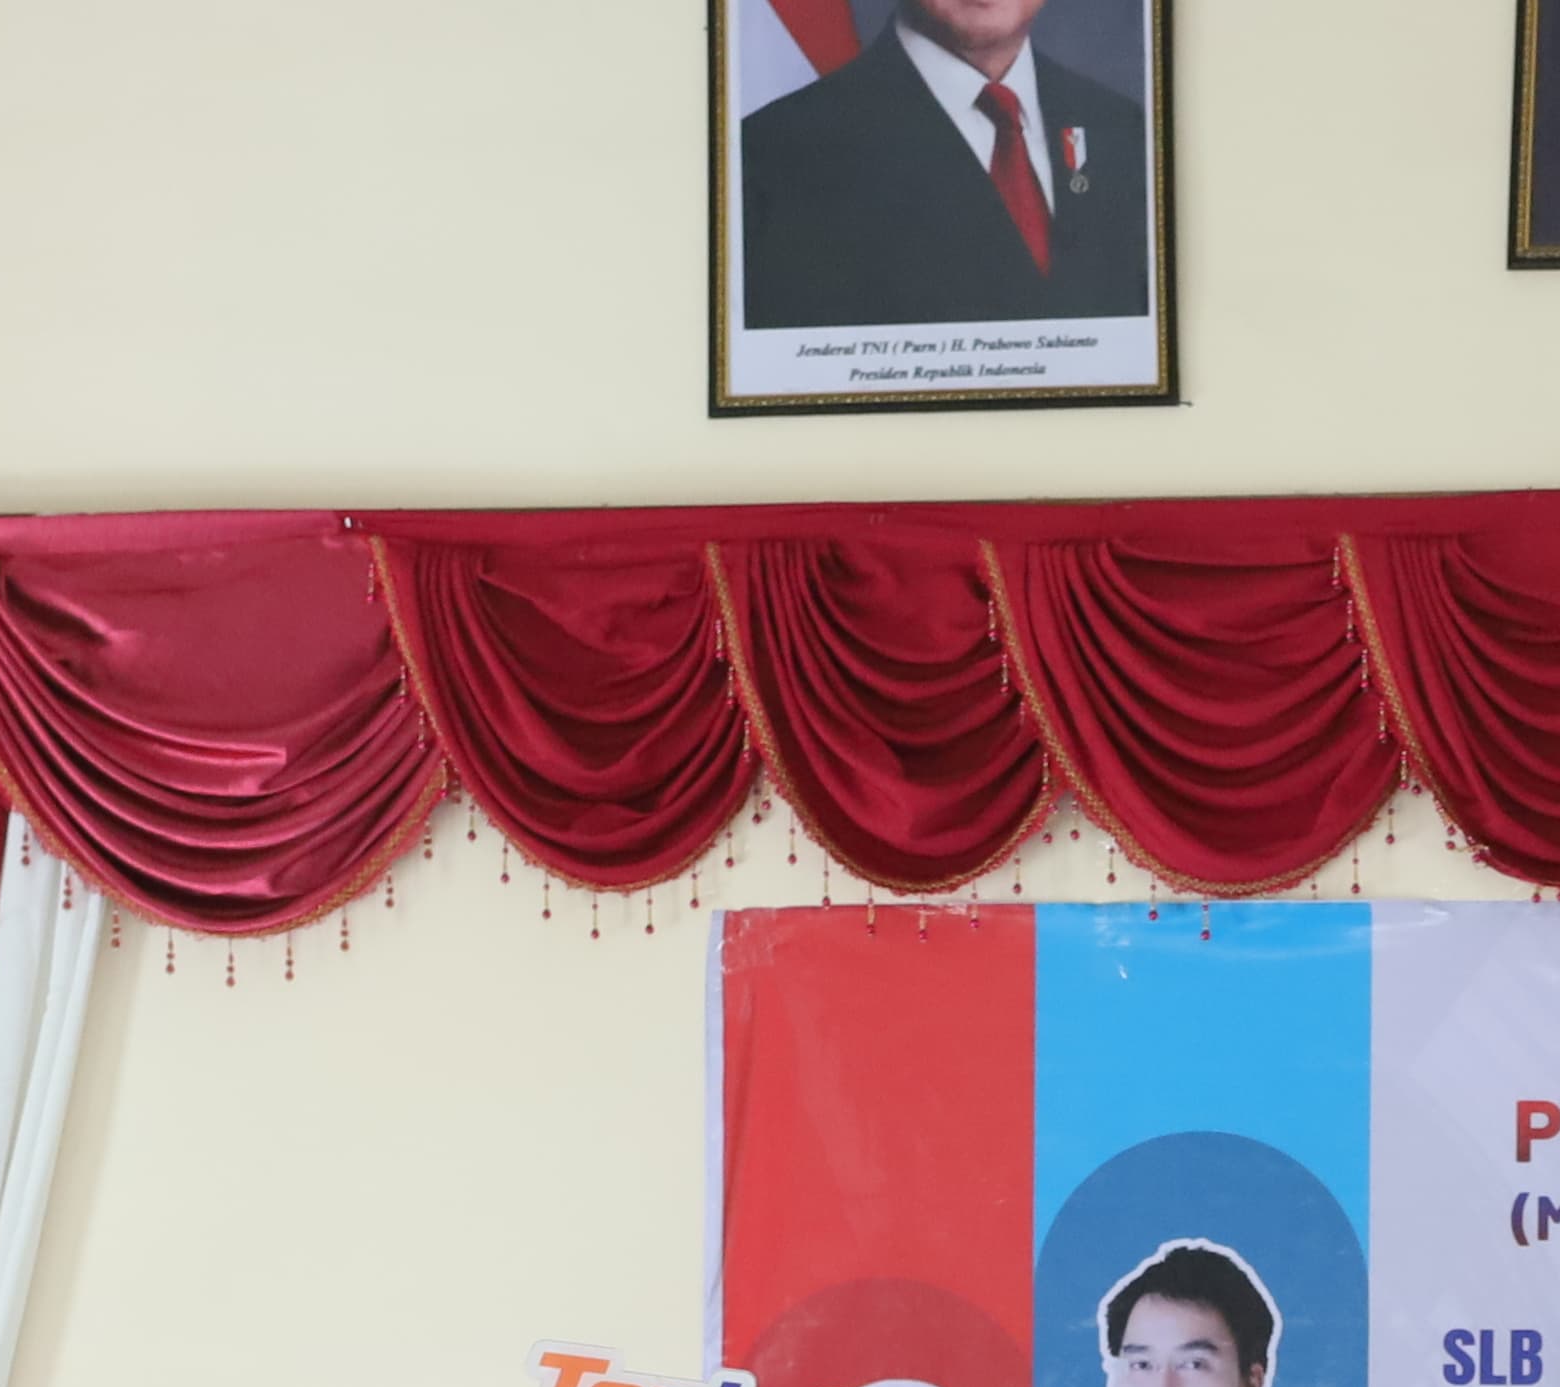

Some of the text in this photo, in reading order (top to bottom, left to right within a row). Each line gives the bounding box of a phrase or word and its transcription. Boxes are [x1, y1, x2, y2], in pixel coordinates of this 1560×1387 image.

[796, 343, 856, 358] Jenderal
[861, 341, 888, 355] TNI
[972, 336, 1031, 351] Prabowo
[1036, 334, 1098, 349] Subianto
[849, 362, 1046, 381] Presiden Republik Indonesia
[1441, 1329, 1543, 1386] SLB
